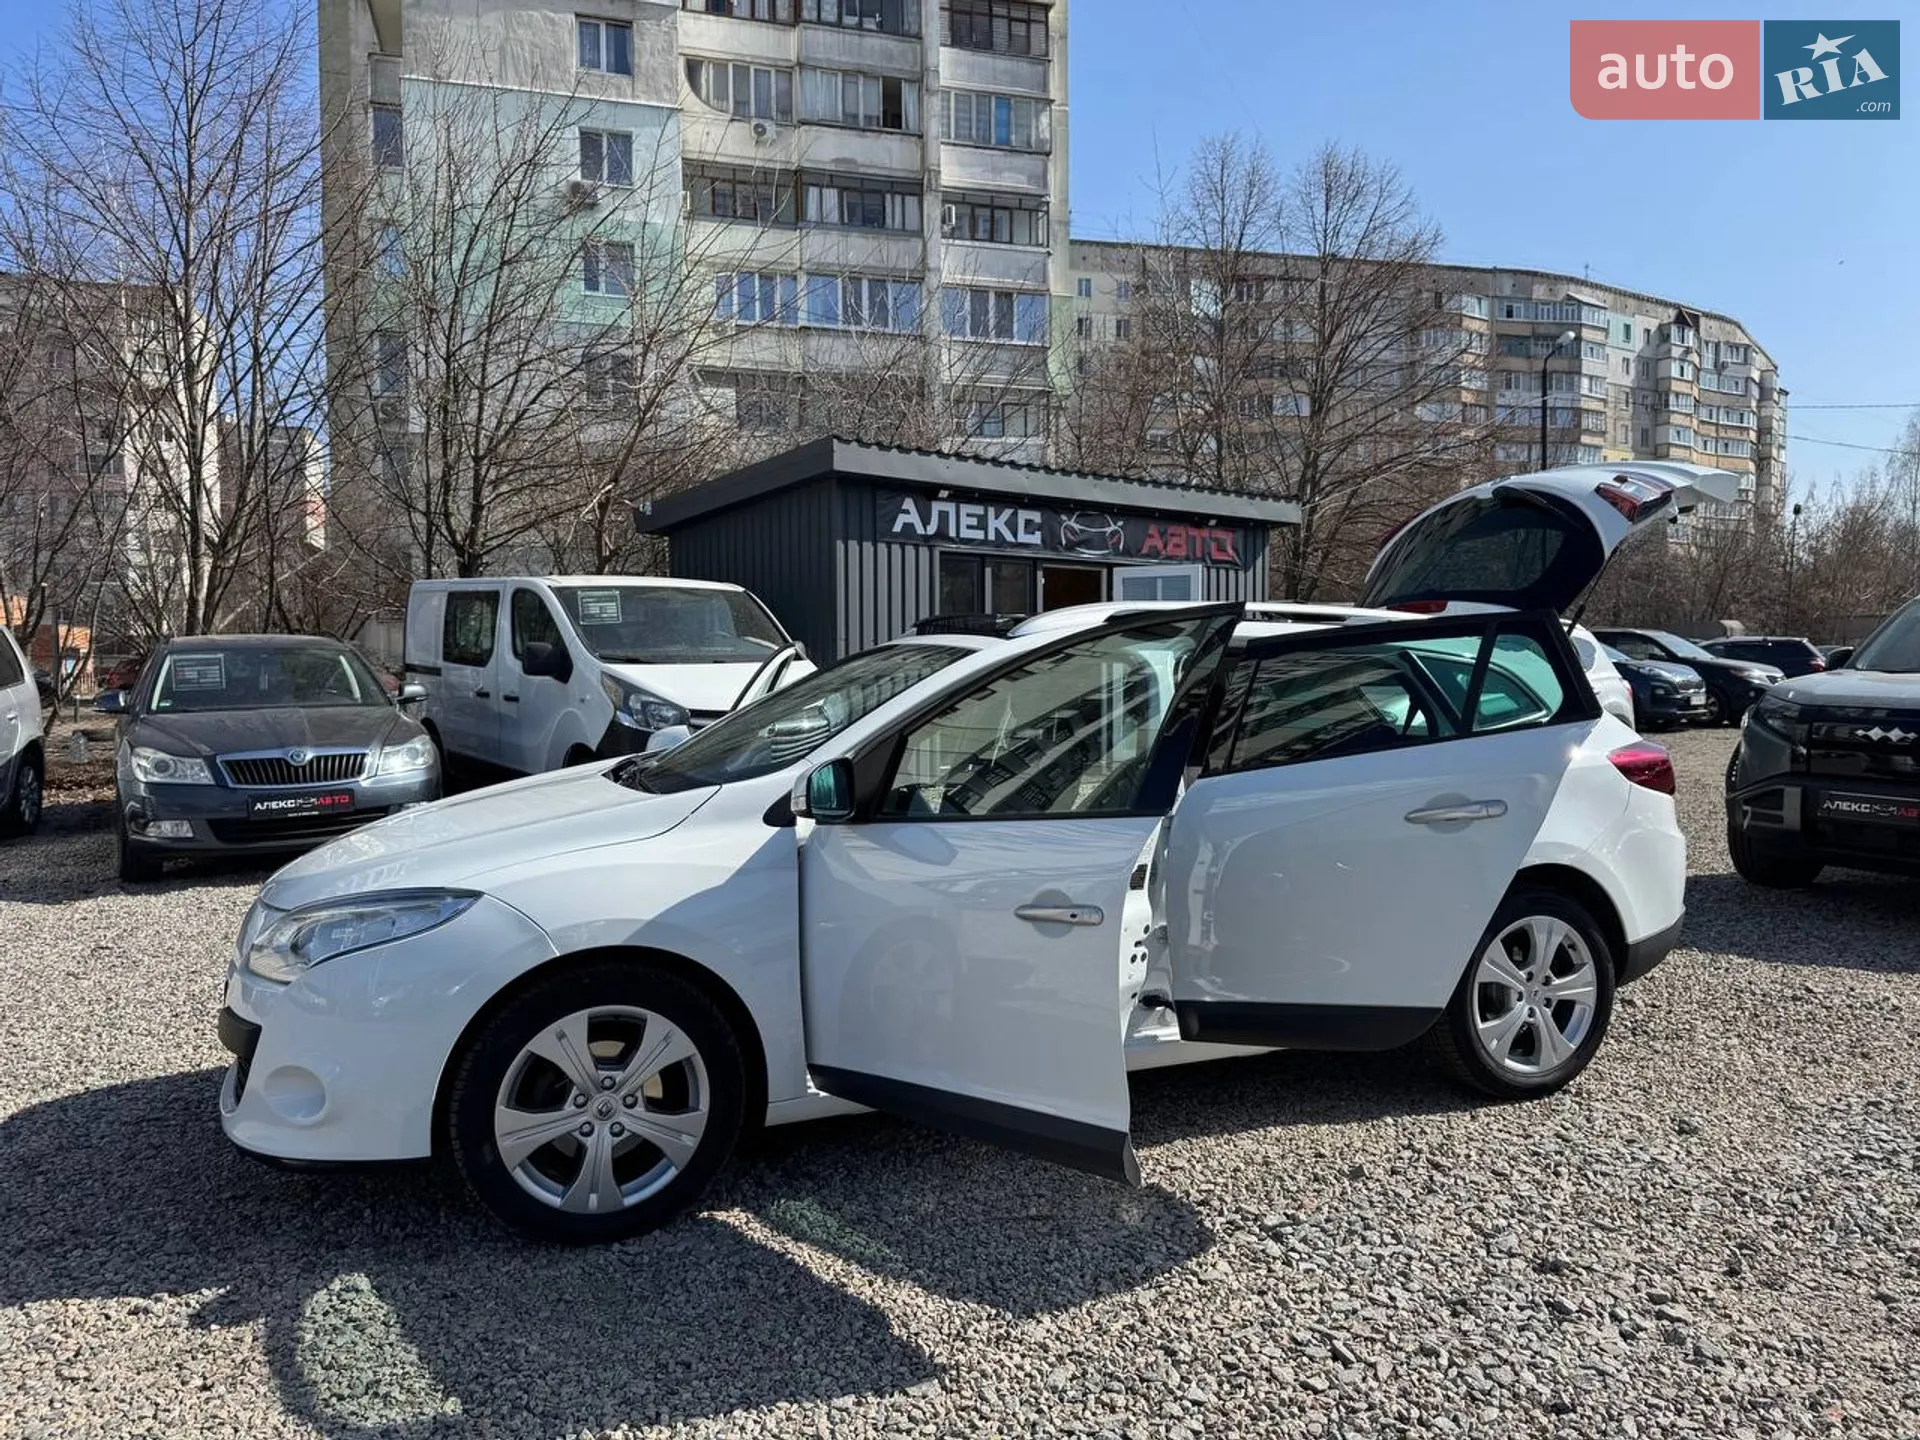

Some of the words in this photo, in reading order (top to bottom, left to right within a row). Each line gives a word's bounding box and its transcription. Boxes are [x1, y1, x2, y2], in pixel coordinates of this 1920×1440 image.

[892, 497, 1042, 544] АЛЕКС
[1138, 523, 1237, 561] АВТО
[254, 799, 296, 811] АЛЕКС
[1823, 799, 1871, 813] АЛЕКС
